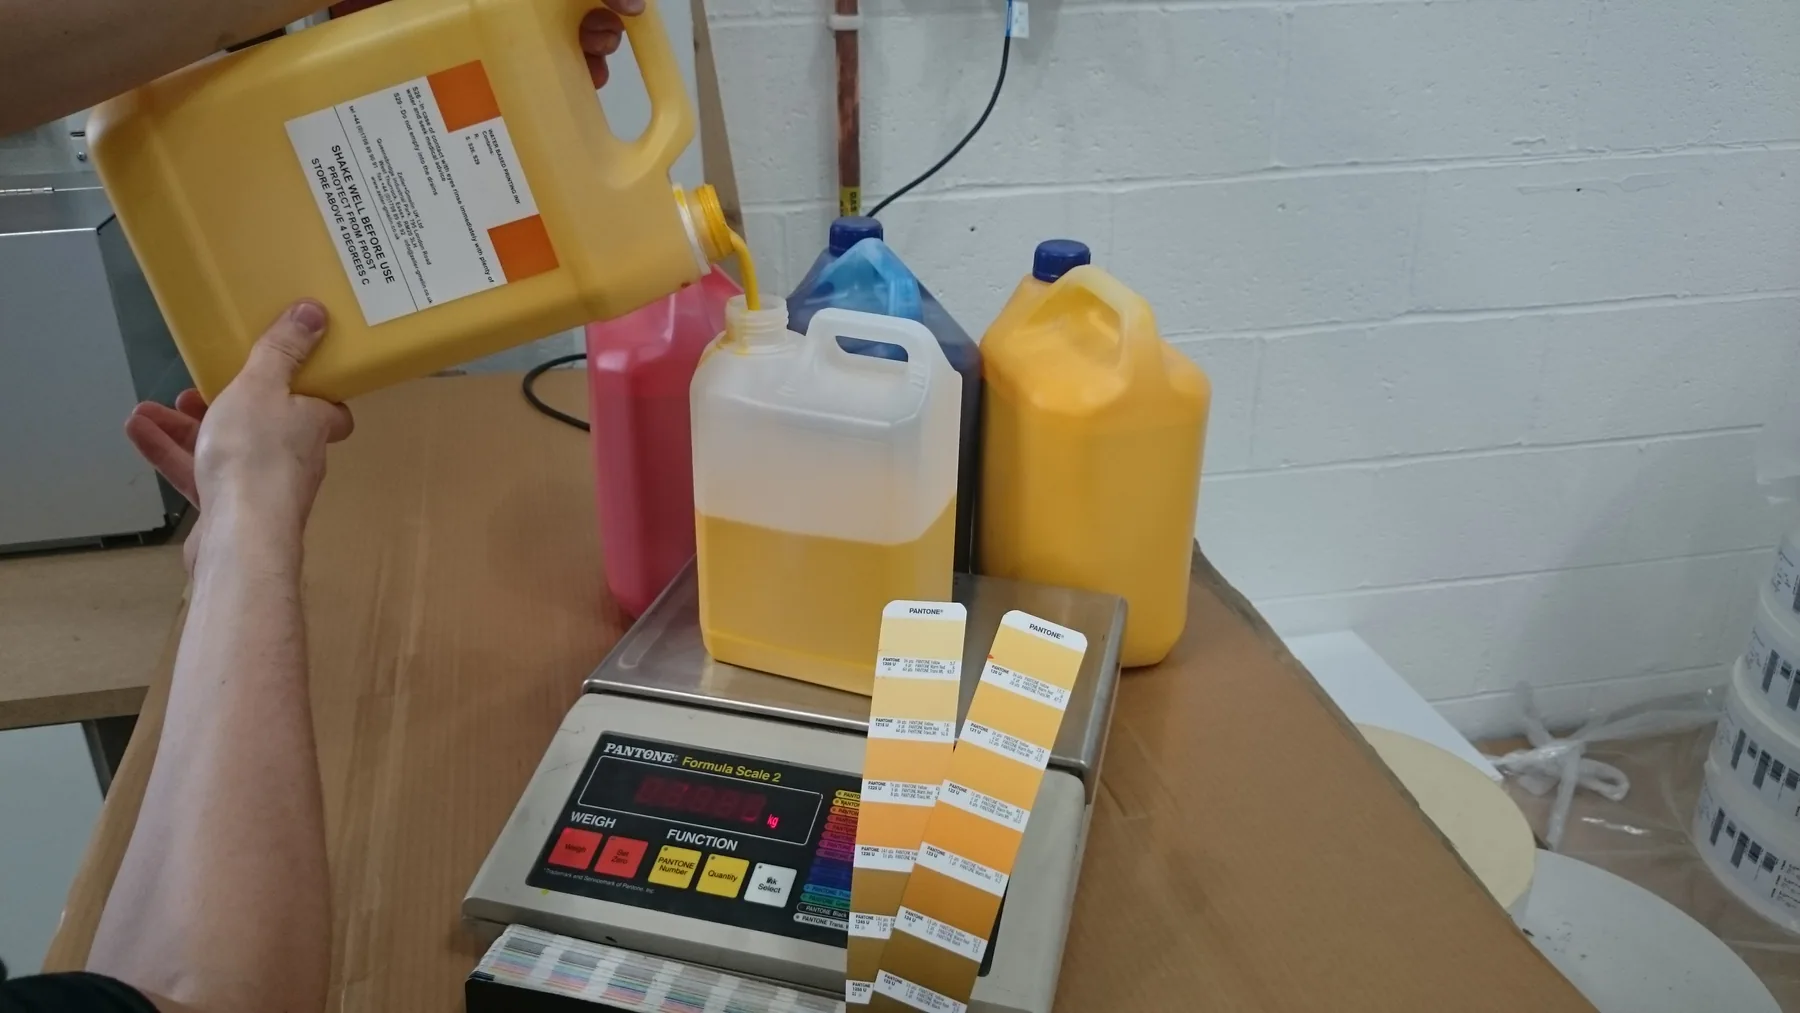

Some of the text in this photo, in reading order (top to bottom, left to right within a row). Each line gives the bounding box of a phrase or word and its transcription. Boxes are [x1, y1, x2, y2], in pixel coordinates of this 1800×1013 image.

[393, 92, 402, 105] S29
[412, 86, 421, 99] S26
[400, 109, 408, 119] Do
[422, 111, 430, 126] case
[404, 119, 412, 131] not
[406, 88, 446, 182] water and seek medical advice
[407, 131, 420, 151] empty
[431, 134, 444, 158] contact
[416, 151, 426, 164] into
[440, 158, 450, 172] with
[487, 128, 499, 148] WATER
[495, 148, 506, 168] BASED
[502, 168, 516, 194] PRINTING
[421, 164, 430, 176] the
[426, 176, 438, 196] drains
[445, 173, 455, 188] eyes
[452, 188, 463, 204] rinse
[310, 157, 330, 190] STORE
[324, 190, 344, 224] ABOVE
[341, 232, 366, 276] DEGREES
[360, 277, 370, 286] C
[326, 165, 377, 271] PROTECT FROM FROST
[330, 144, 395, 284] SHAKE WELL BEFORE USE
[412, 209, 420, 219] UK
[416, 219, 424, 229] Ltd
[458, 204, 477, 242] immediately
[474, 242, 483, 255] with
[478, 256, 491, 275] plenty
[1029, 624, 1061, 639] PANTONE
[604, 742, 781, 782] PANTONE Formula Scale 2
[570, 811, 616, 828] WEIGH
[767, 814, 779, 828] kg
[666, 829, 738, 851] FUNCTION
[611, 856, 628, 864] Zero
[658, 857, 695, 869] PANTONE
[659, 865, 688, 876] Number
[708, 870, 738, 882] Quantity
[758, 884, 781, 893] Select
[806, 906, 831, 915] PANTONE
[802, 915, 828, 925] PANTONE
